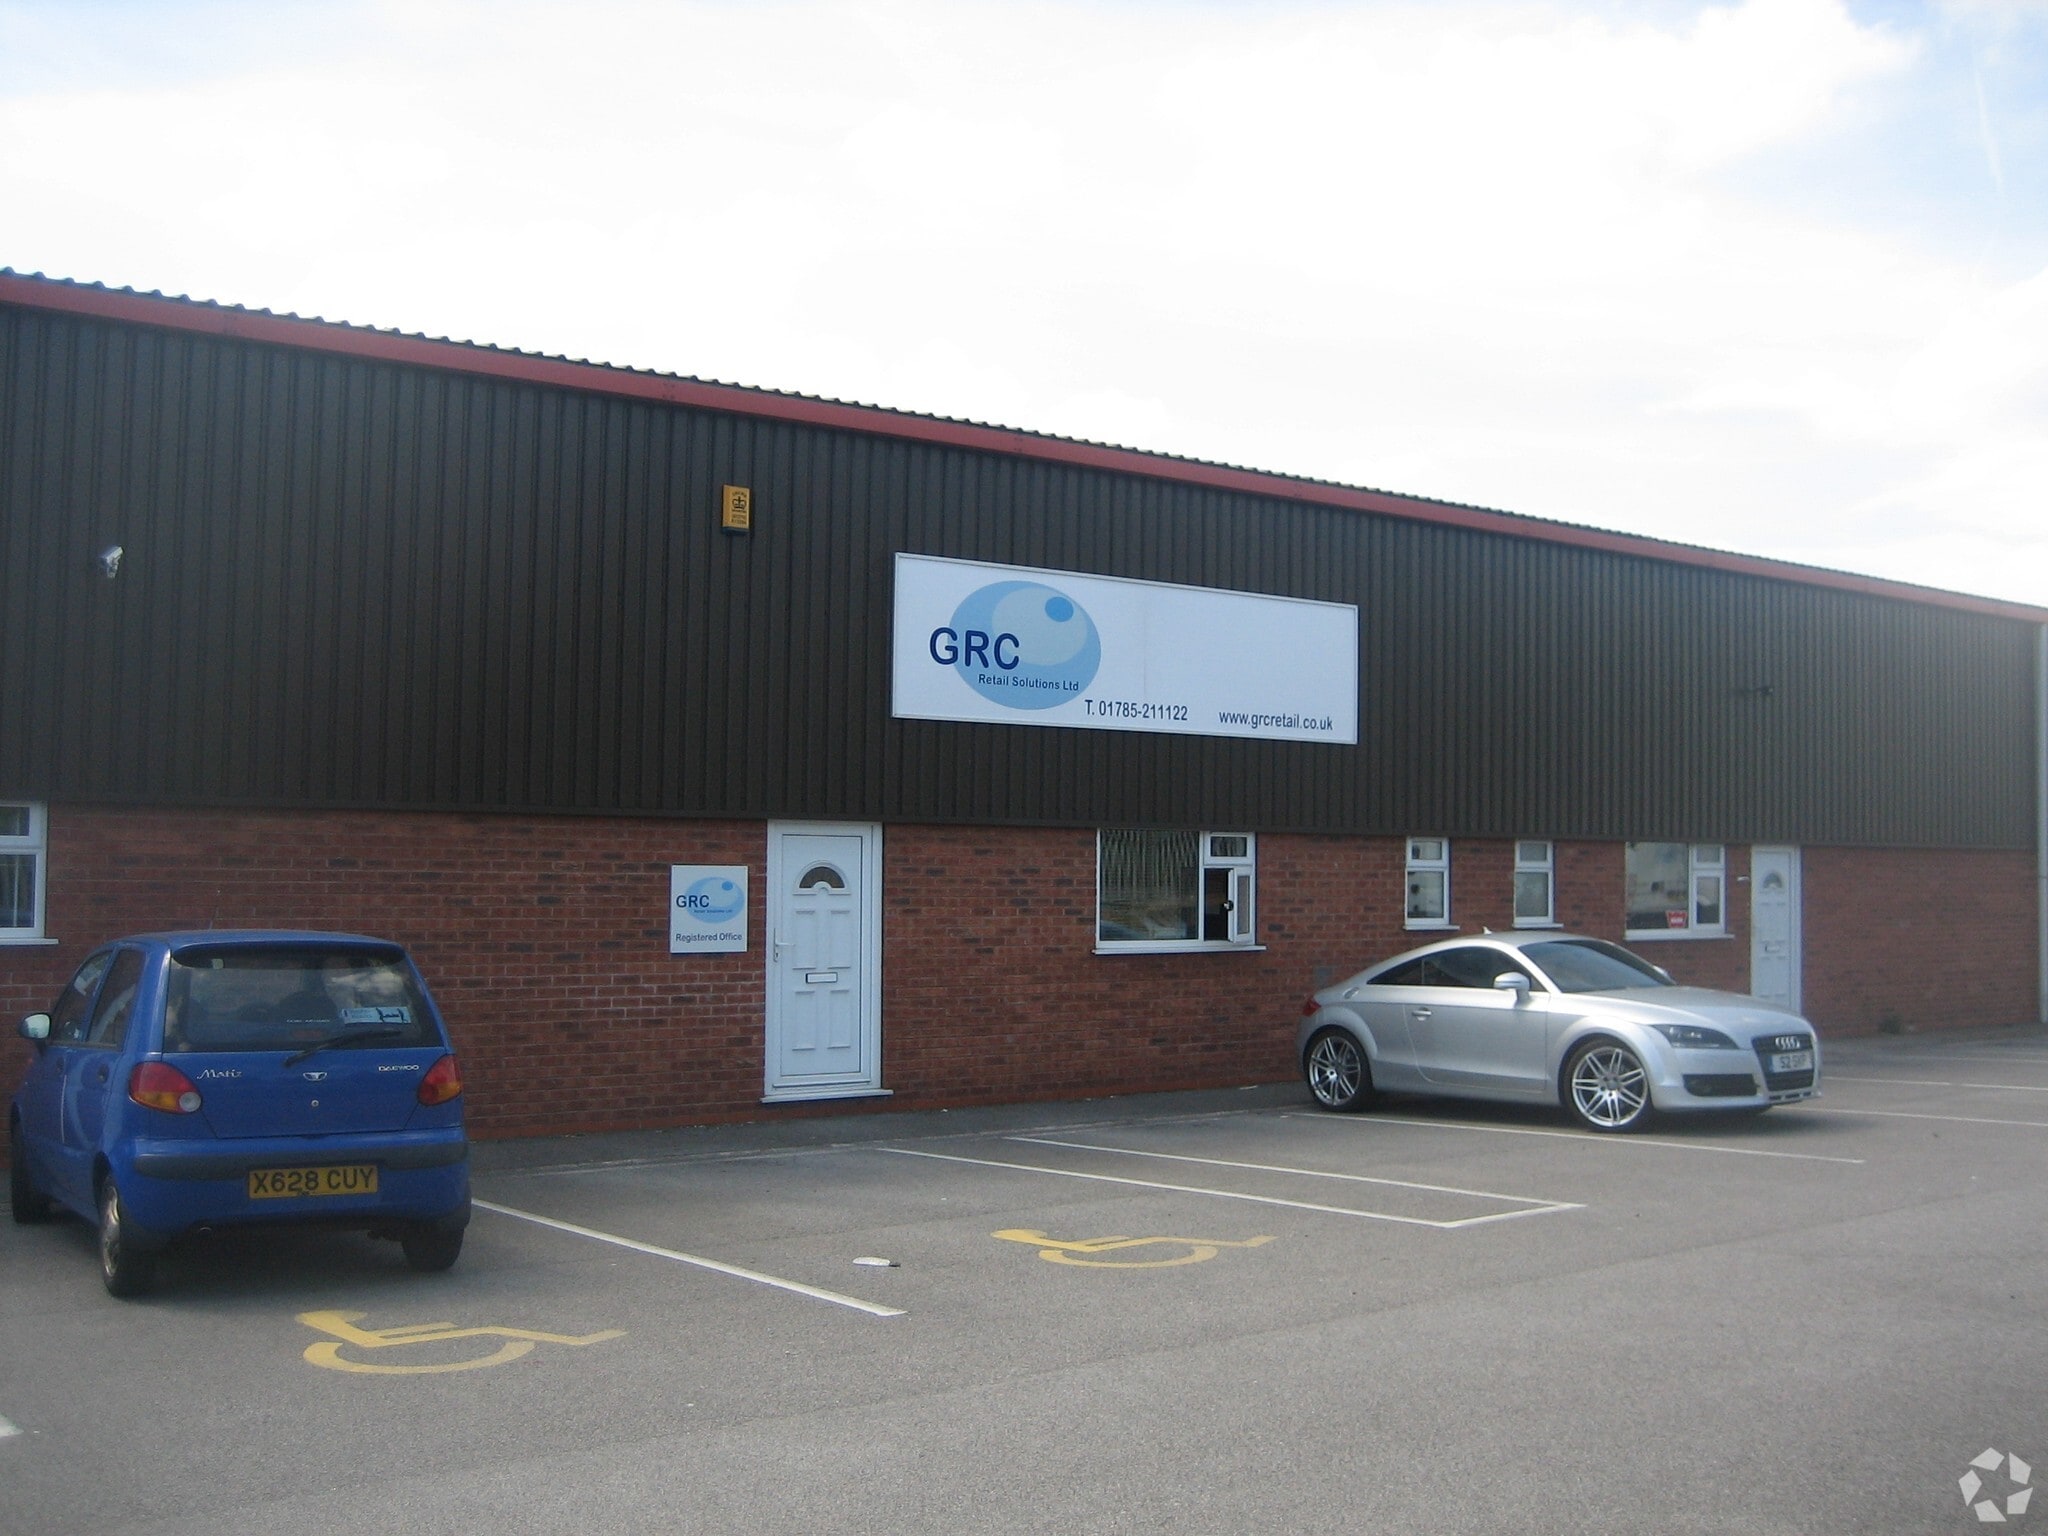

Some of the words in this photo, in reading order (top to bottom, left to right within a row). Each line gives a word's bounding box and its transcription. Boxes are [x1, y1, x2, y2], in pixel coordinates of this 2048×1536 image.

[929, 626, 1020, 670] GRC
[978, 673, 1009, 686] Retail
[1012, 676, 1060, 690] Solutions
[1063, 681, 1079, 691] Ltd
[1085, 699, 1095, 716] T.
[1099, 700, 1188, 721] 01785-211122
[1219, 710, 1333, 731] www.grcretail.co.uk
[676, 894, 710, 908] GRC
[675, 933, 718, 943] Registered
[719, 932, 743, 941] Office
[196, 1068, 242, 1079] Matiz
[378, 1064, 419, 1072] DAEWOO
[253, 1170, 320, 1194] X628
[326, 1167, 374, 1191] CUY
